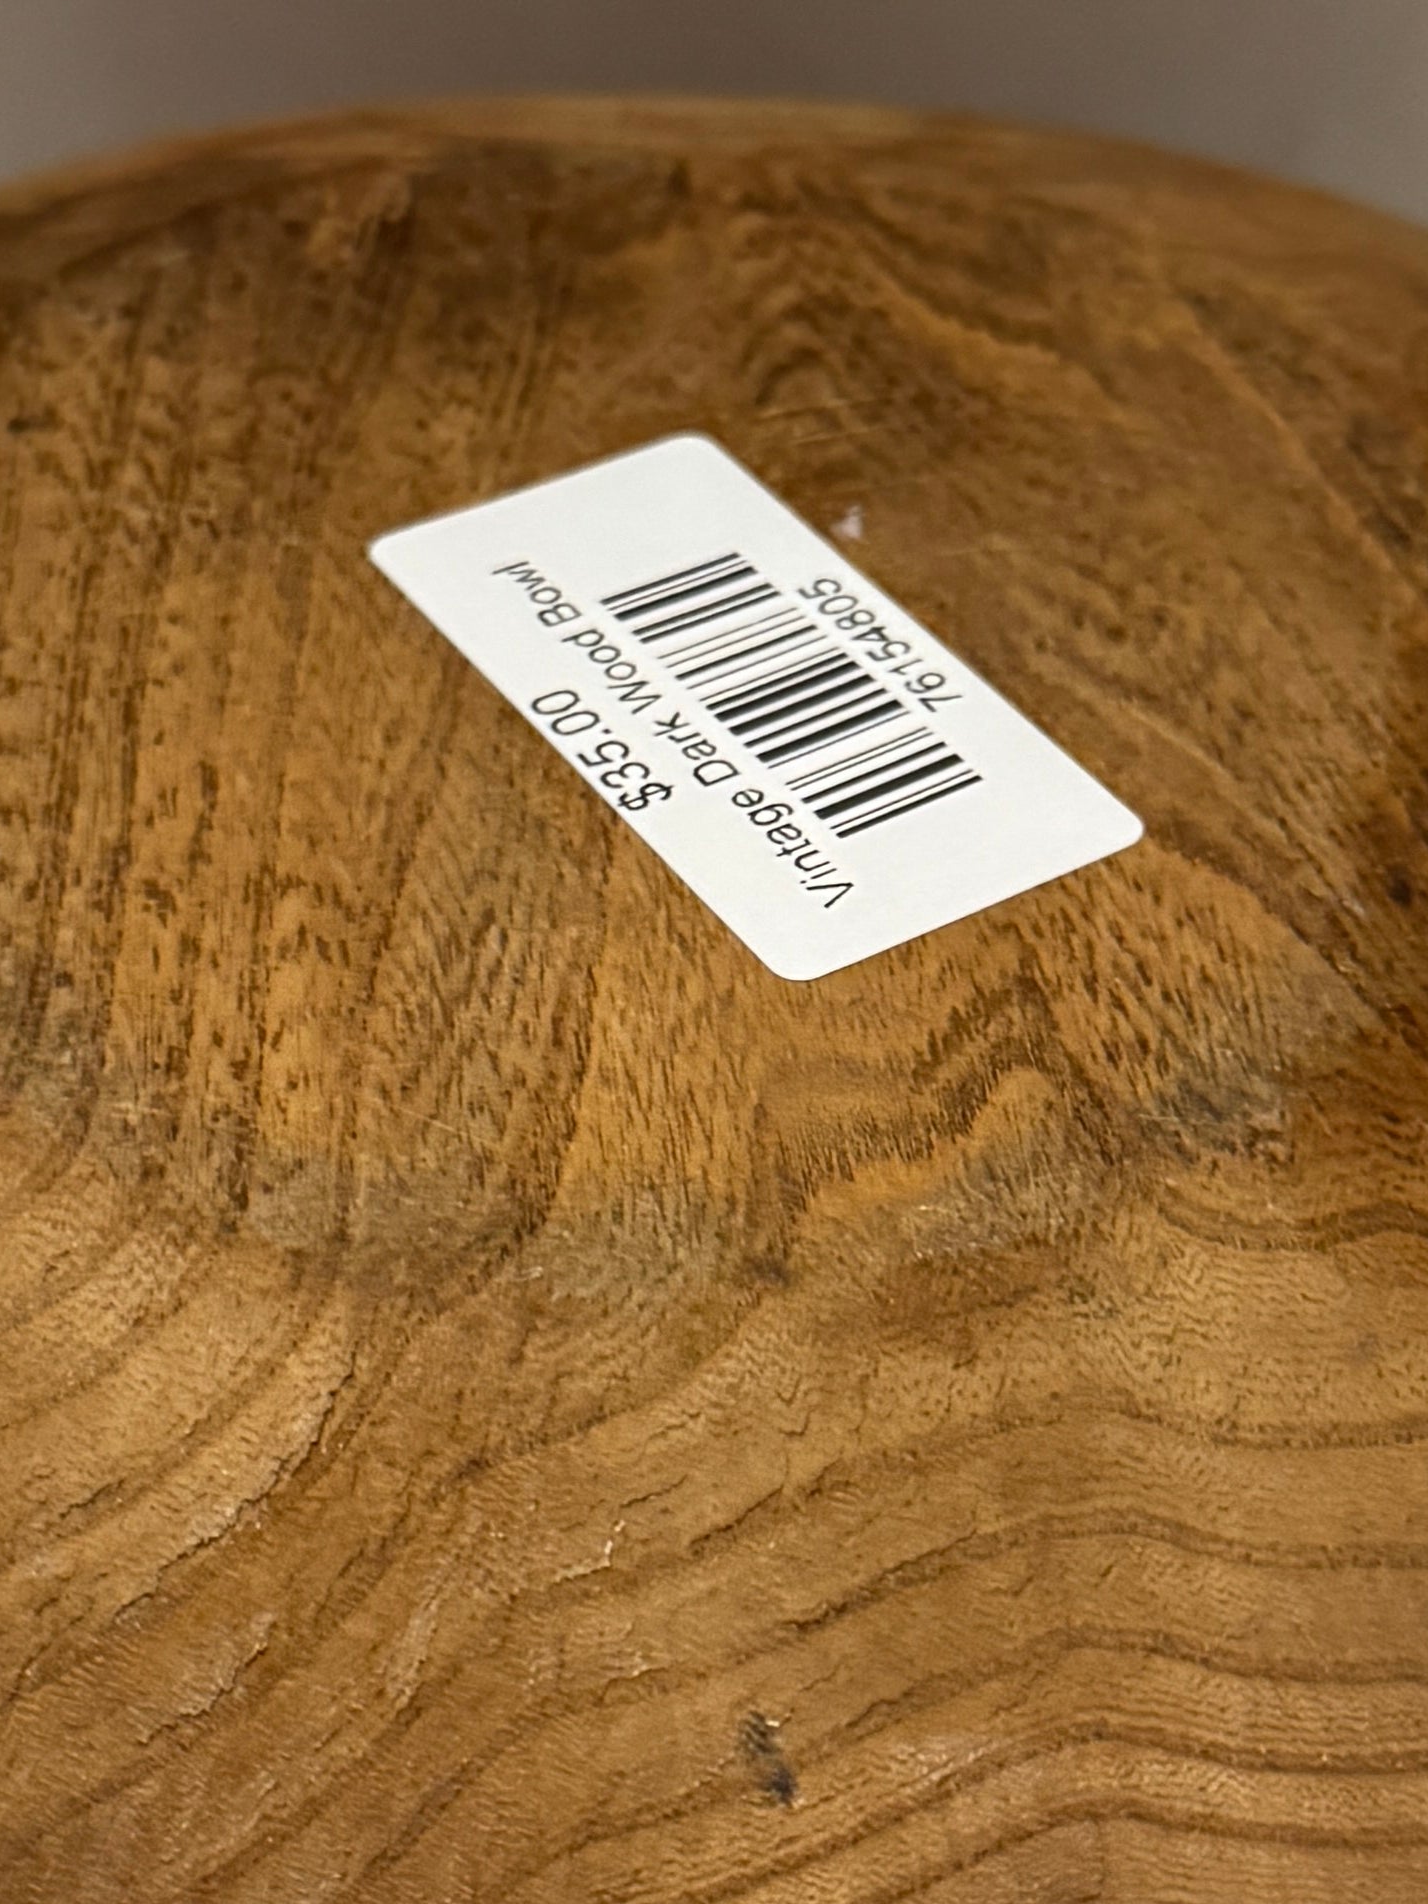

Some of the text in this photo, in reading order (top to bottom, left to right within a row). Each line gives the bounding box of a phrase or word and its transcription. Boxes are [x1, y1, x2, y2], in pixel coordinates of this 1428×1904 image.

[797, 577, 964, 714] 76154805
[491, 559, 856, 910] Vintage Dark Wood Bowl
[530, 688, 675, 813] $35.00
